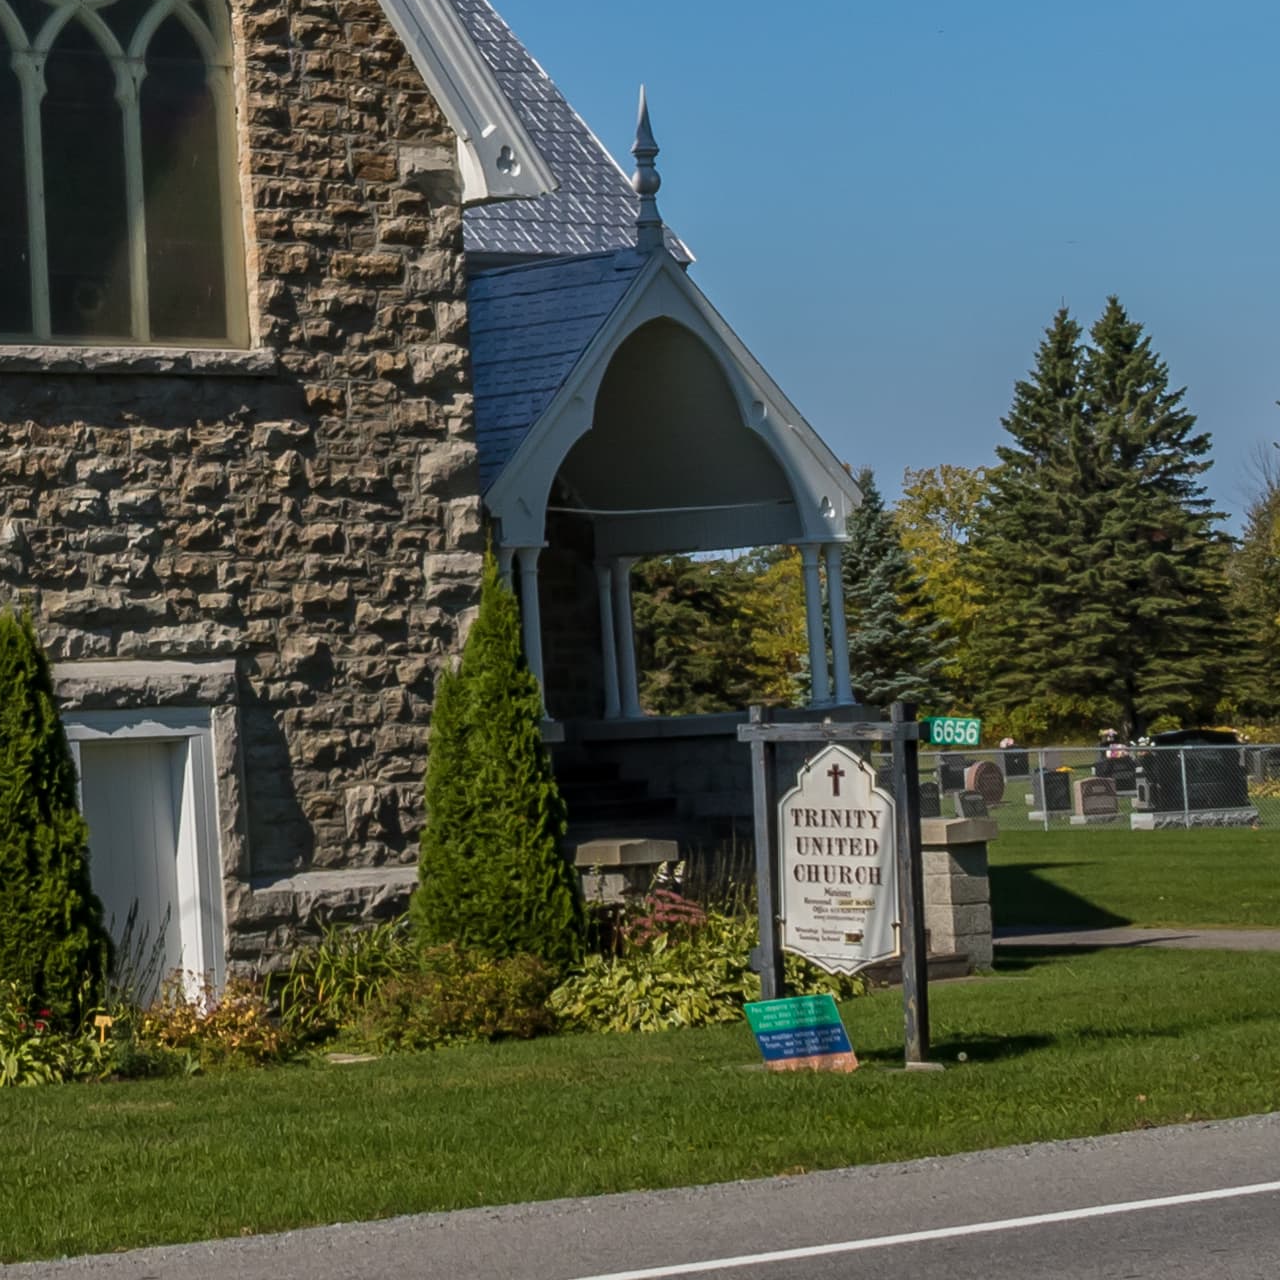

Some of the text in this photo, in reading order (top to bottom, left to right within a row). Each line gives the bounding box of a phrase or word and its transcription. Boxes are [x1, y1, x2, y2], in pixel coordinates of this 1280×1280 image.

[933, 720, 977, 744] 6656
[790, 808, 882, 829] TRINITY
[795, 836, 880, 857] UNITED
[793, 864, 883, 886] CHURCH
